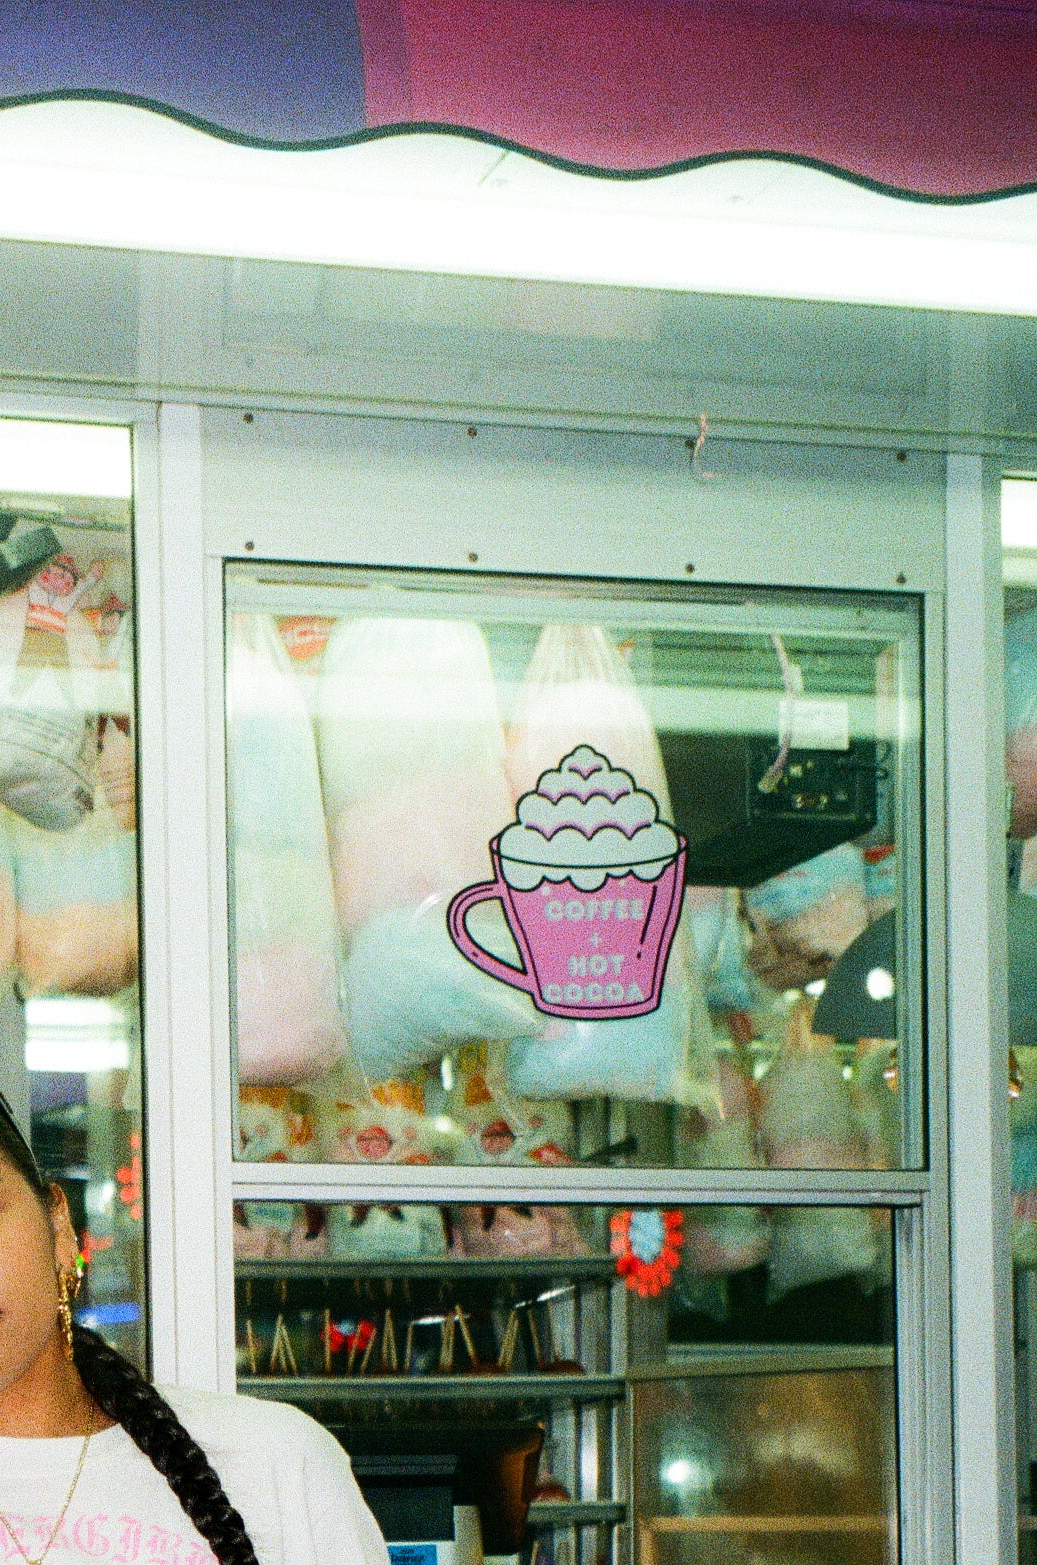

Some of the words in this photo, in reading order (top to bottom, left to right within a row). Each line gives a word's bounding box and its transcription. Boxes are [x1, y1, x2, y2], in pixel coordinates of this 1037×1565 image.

[545, 900, 644, 921] COFFEE
[589, 930, 603, 948] +
[568, 954, 625, 978] HOT
[542, 981, 645, 1003] COCOA
